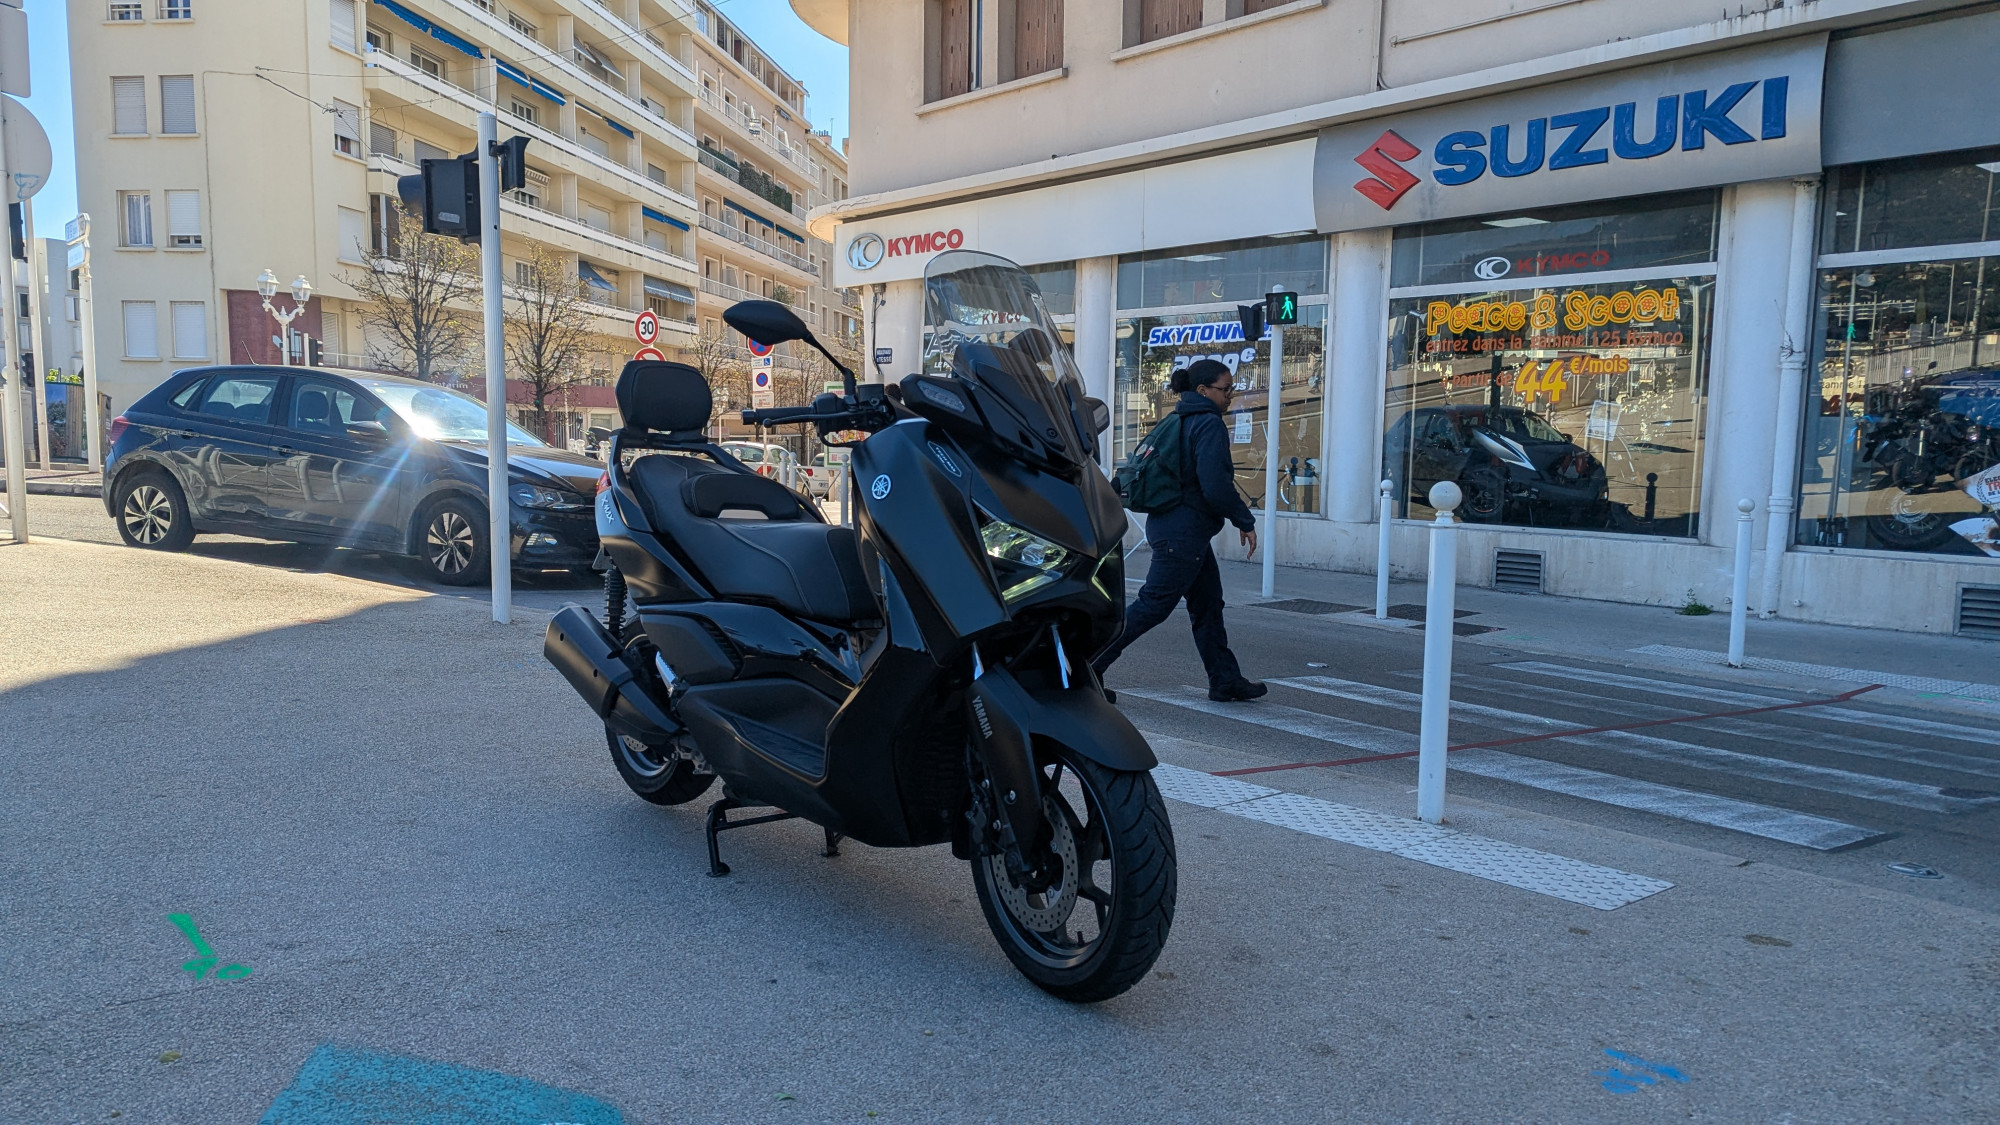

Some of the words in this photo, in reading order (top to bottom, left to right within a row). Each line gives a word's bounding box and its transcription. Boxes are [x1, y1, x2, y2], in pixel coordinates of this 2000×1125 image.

[1434, 75, 1789, 186] SUZUKI
[887, 228, 964, 258] KYMCO
[1517, 250, 1610, 273] KYMCO
[640, 320, 654, 336] 30
[1427, 301, 1526, 336] Peace
[1531, 294, 1557, 330] &
[1149, 321, 1245, 347] SKYTOWN
[1426, 336, 1468, 353] entrez
[1472, 334, 1505, 351] dans
[1510, 333, 1522, 350] la
[1530, 333, 1585, 350] gamme
[1593, 330, 1621, 347] 125
[1626, 329, 1684, 347] Kymco
[1453, 371, 1491, 388] partir
[1496, 371, 1513, 386] de
[1514, 360, 1568, 404] 44
[1570, 354, 1630, 375] €/mois
[972, 695, 993, 740] YAMAHA
